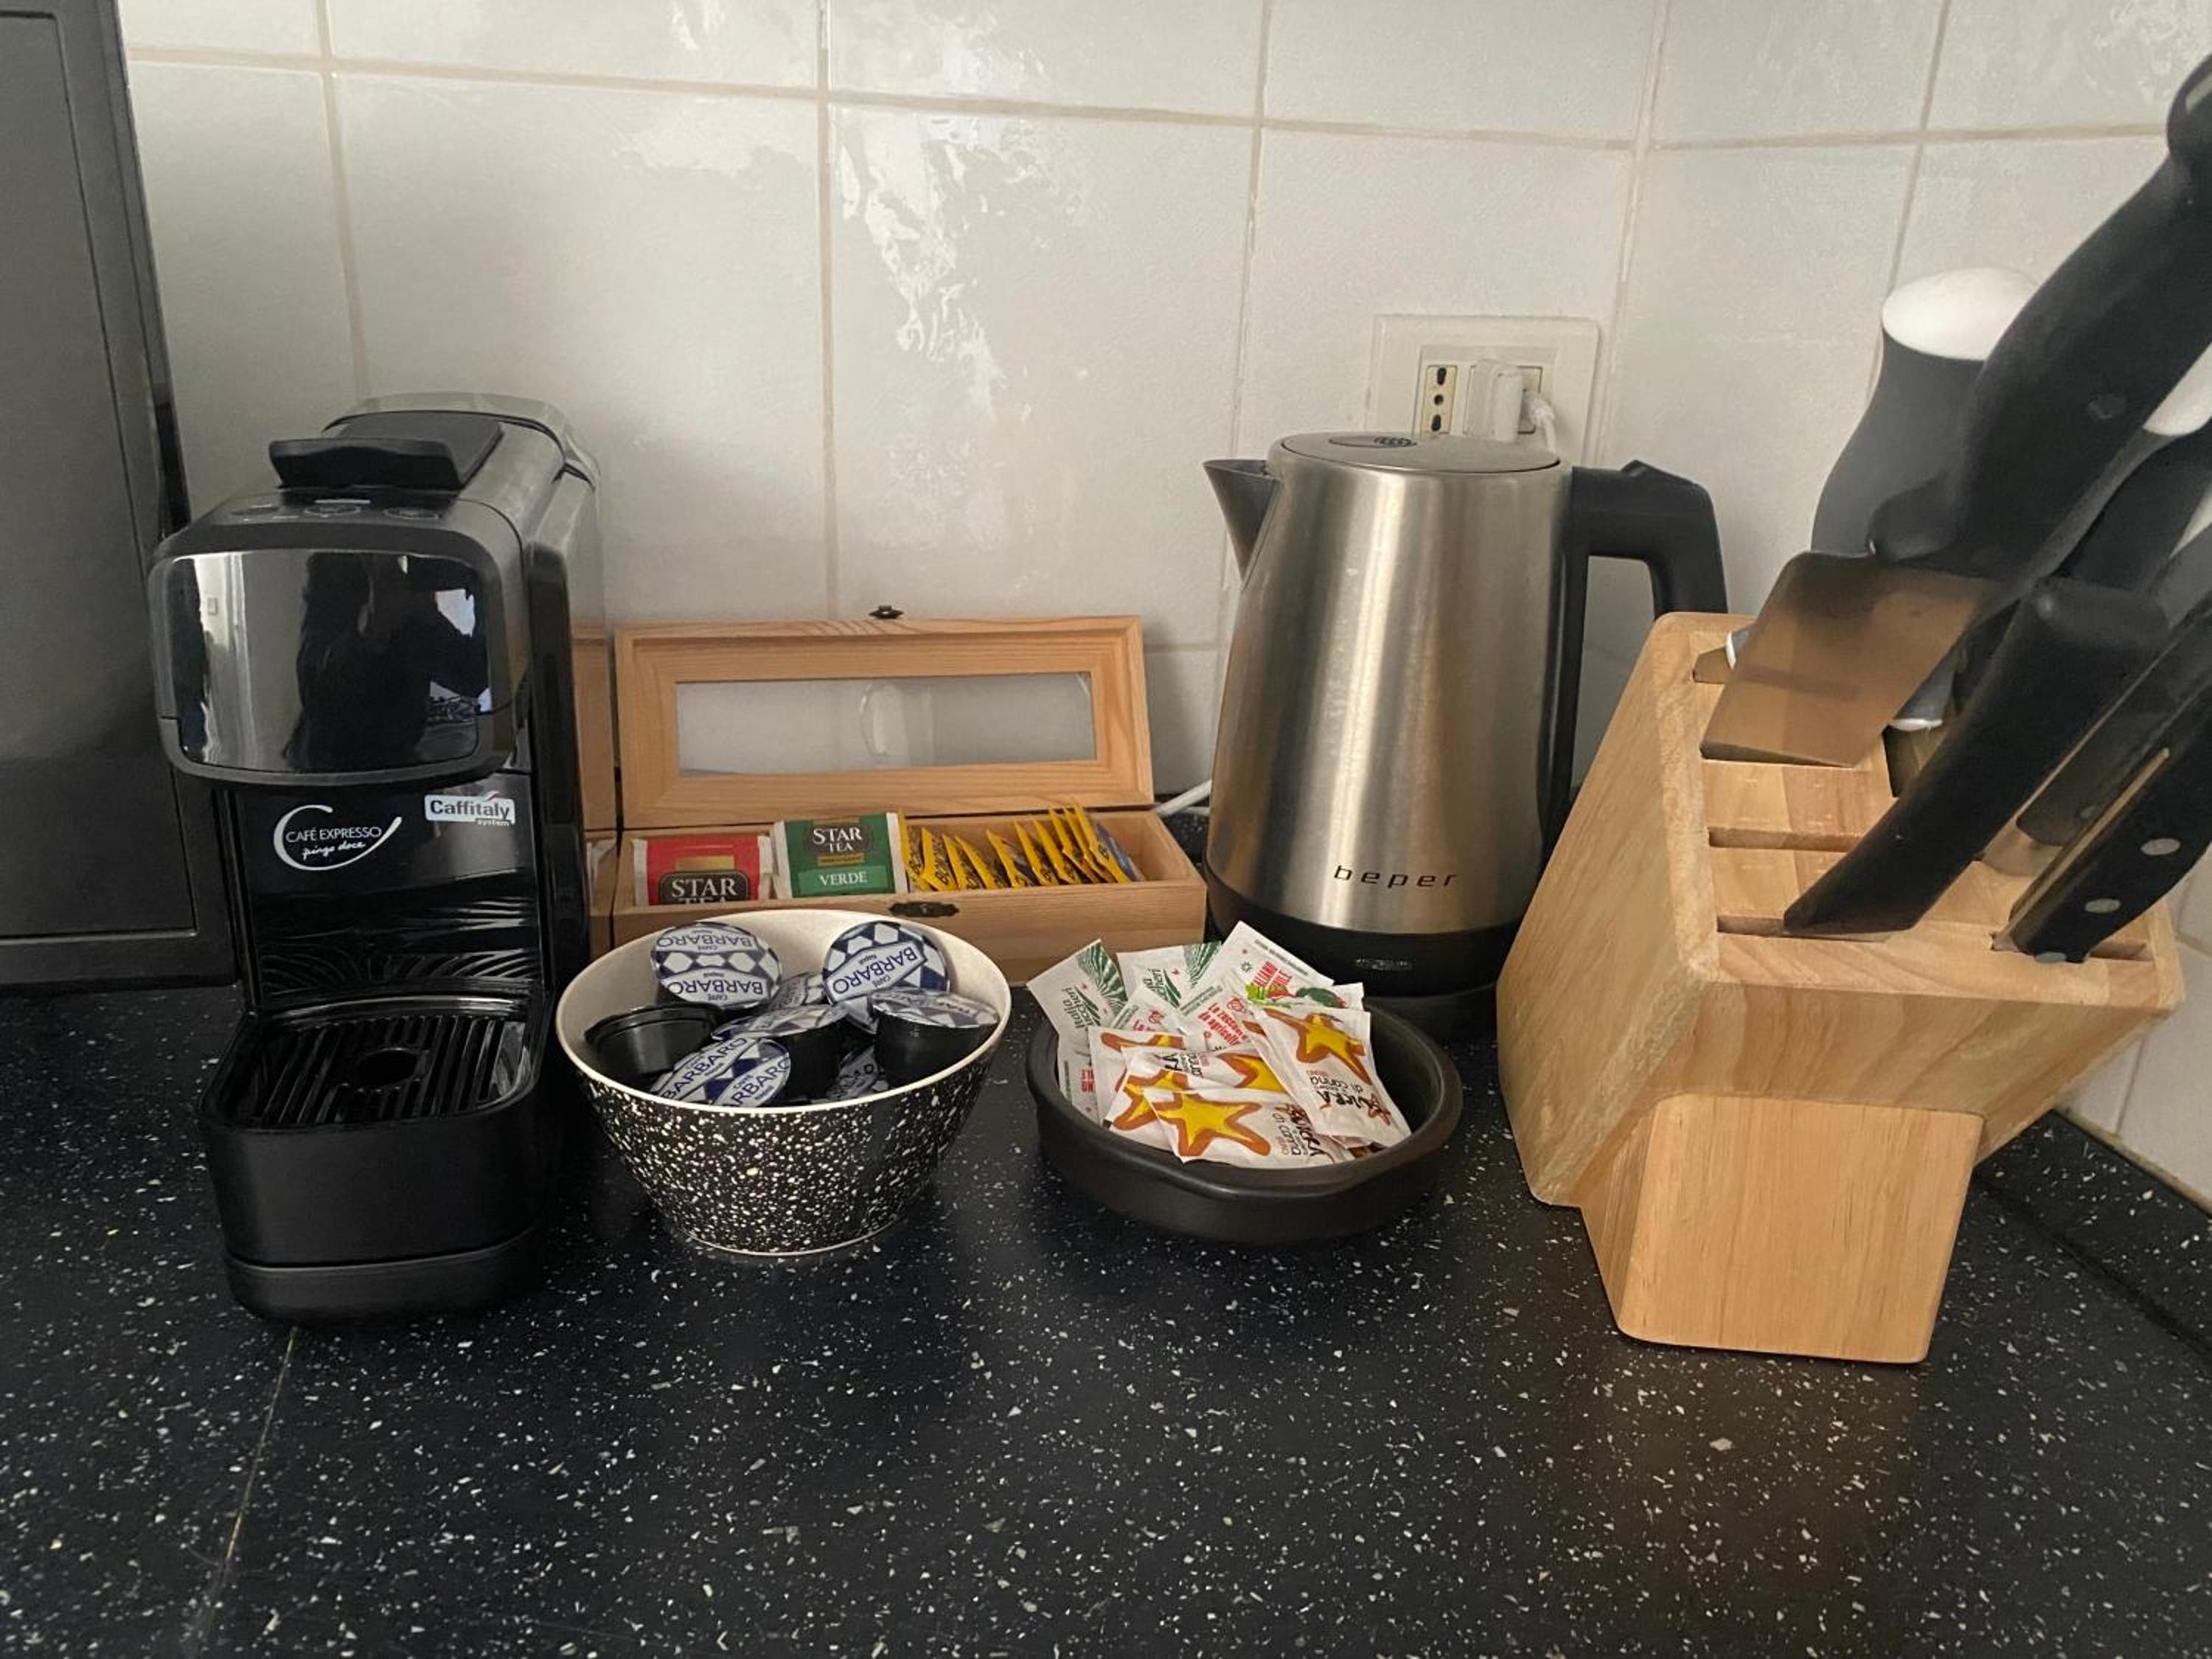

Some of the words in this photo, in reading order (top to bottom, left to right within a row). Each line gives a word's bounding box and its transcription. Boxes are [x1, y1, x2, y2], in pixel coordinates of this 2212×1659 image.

[430, 799, 510, 820] Caffitaly
[285, 827, 317, 843] CAFÉ
[319, 826, 383, 840] EXPRESSO
[813, 827, 863, 845] STAR
[823, 842, 853, 853] TEA
[819, 871, 867, 886] VERDE
[1334, 865, 1458, 888] beper
[672, 877, 737, 897] STAR
[656, 934, 753, 947] BARBARO
[832, 946, 918, 994] BARBARO
[667, 979, 764, 995] BARBARO
[661, 1037, 748, 1099] BARBARO
